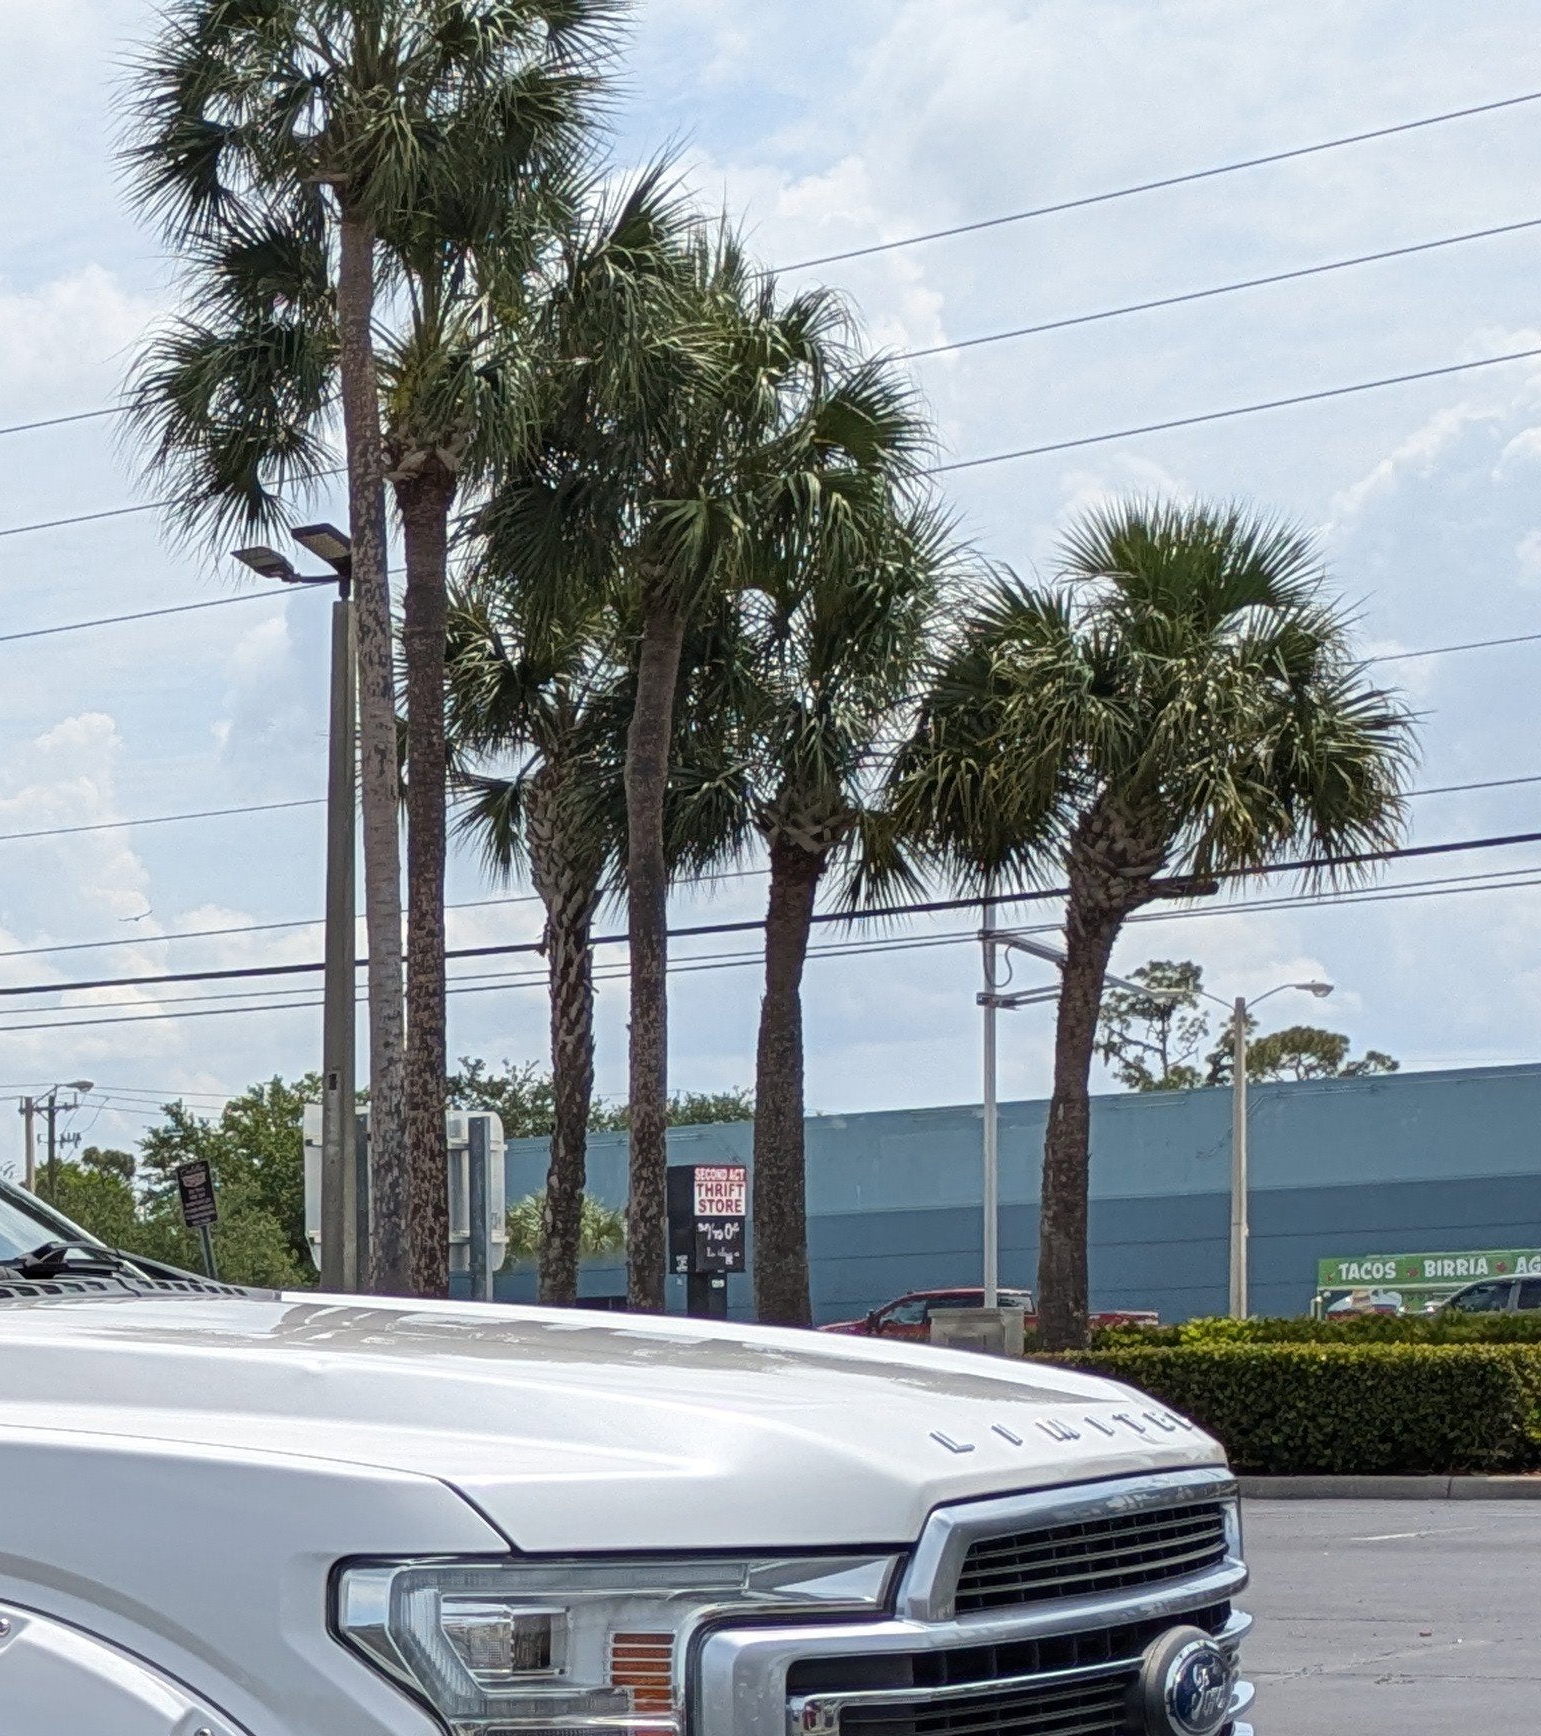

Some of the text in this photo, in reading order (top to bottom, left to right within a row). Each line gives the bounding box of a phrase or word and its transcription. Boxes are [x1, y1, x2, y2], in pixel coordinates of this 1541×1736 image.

[696, 1183, 743, 1197] THRIFT
[698, 1199, 742, 1213] STORE
[1338, 1261, 1397, 1280] TACOS
[1423, 1256, 1489, 1278] BIRRIA
